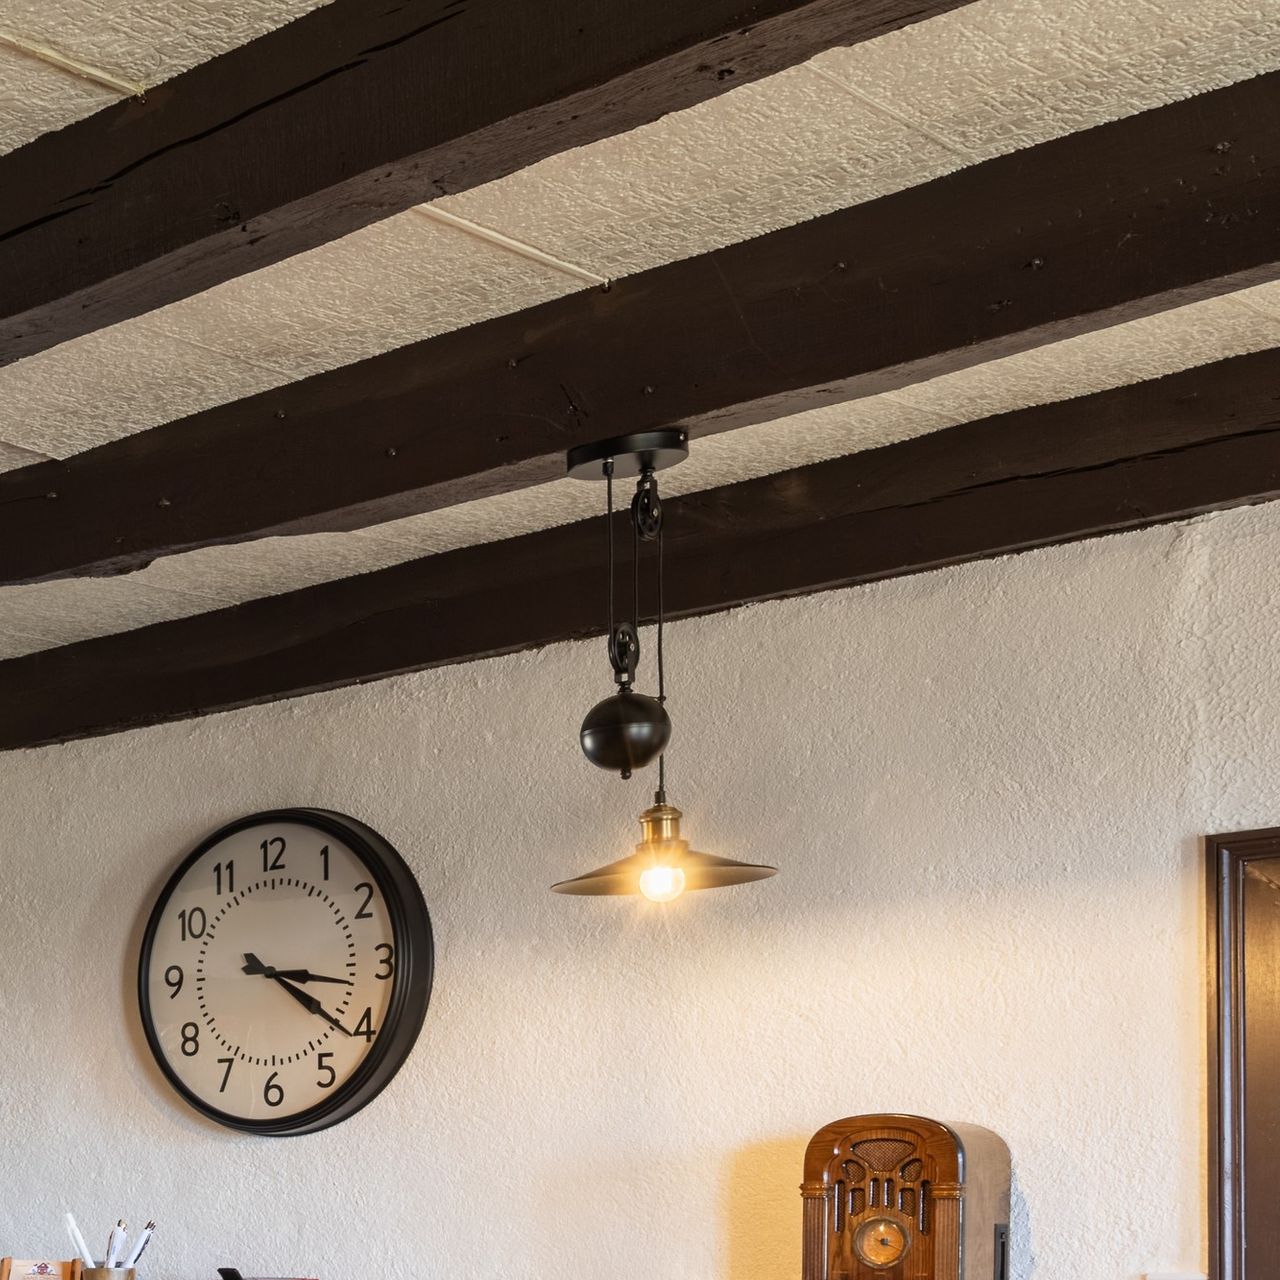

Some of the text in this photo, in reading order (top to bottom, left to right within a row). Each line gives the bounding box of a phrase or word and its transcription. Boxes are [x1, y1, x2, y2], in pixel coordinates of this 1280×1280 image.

[260, 837, 286, 872] 12
[319, 845, 329, 880] 1
[213, 860, 235, 896] 11
[354, 882, 374, 919] 2
[178, 907, 207, 941] 10
[374, 943, 394, 980] 3
[165, 965, 184, 999] 9
[181, 1022, 199, 1056] 8
[352, 1006, 376, 1043] 4
[217, 1057, 234, 1092] 7
[316, 1052, 336, 1088] 5
[263, 1072, 284, 1106] 6
